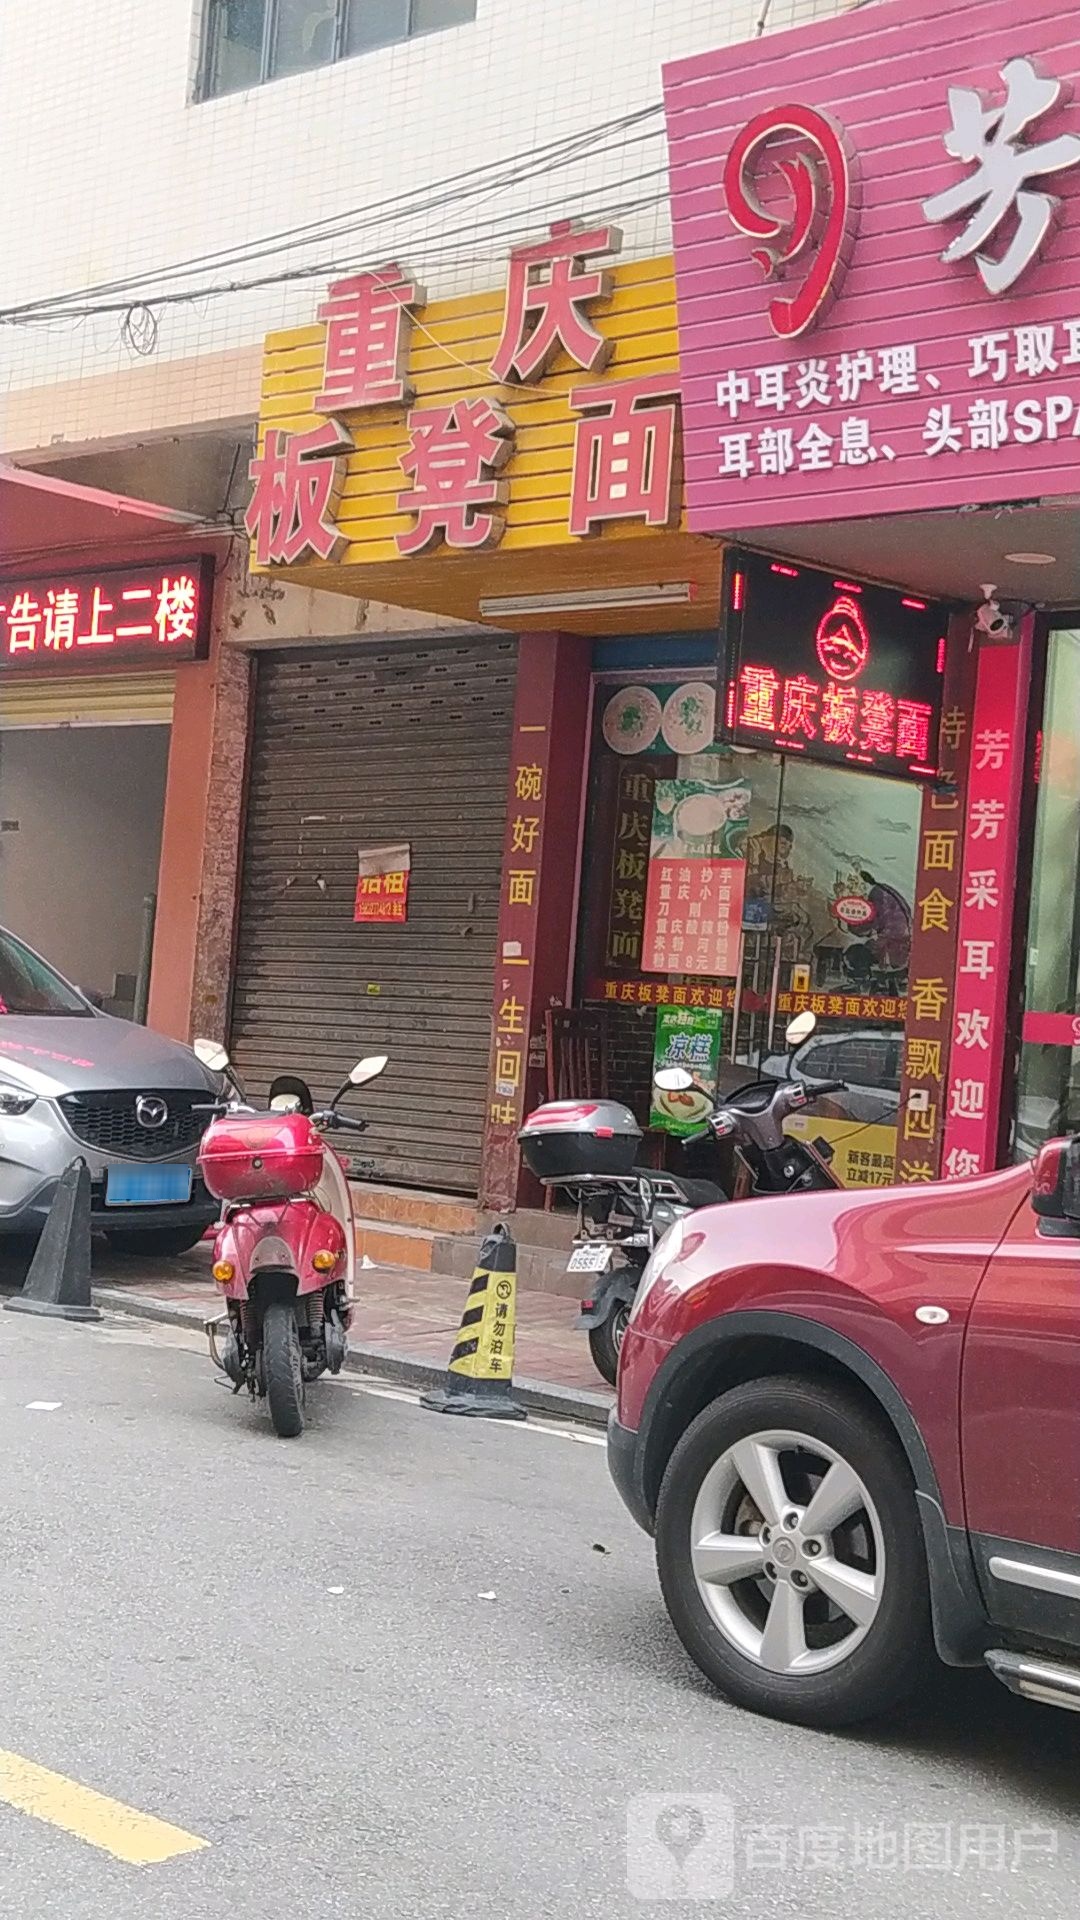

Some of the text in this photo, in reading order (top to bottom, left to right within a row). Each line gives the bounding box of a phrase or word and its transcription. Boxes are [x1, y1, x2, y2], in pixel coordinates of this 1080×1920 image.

[313, 219, 622, 415] 重庆
[243, 371, 684, 566] 板凳面
[717, 395, 1080, 479] 耳部全息、头部SP
[0, 575, 196, 654] 告请上二楼
[739, 664, 932, 762] 重庆板凳面
[611, 773, 653, 960] 重庆板凳面
[658, 883, 732, 902] 重庆小面
[660, 866, 733, 884] 红油抄手
[944, 728, 1010, 1180] 芳芳采耳欢迎您
[488, 1302, 508, 1373] 请勿泊车
